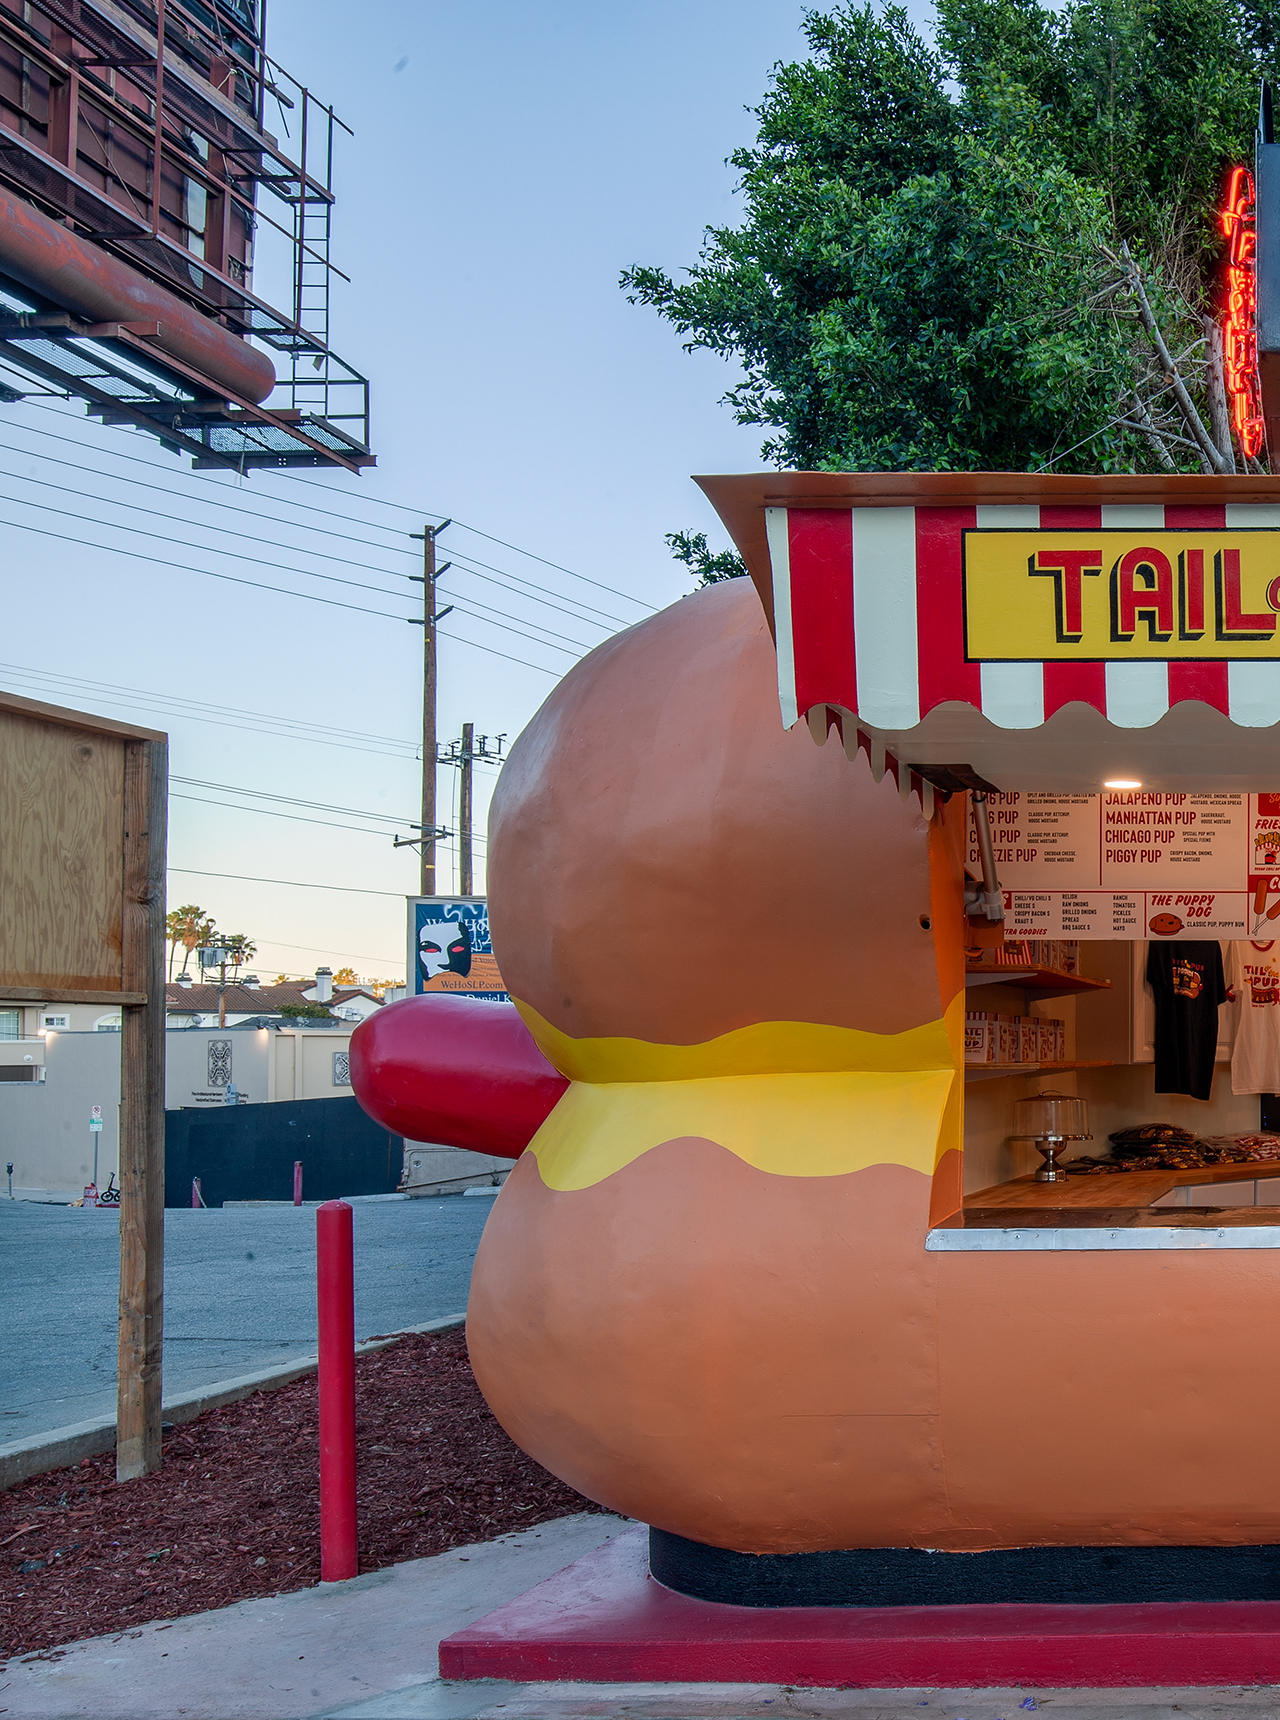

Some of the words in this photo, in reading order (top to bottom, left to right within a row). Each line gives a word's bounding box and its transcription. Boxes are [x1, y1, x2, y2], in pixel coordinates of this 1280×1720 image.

[1028, 546, 1278, 643] TAIL
[999, 792, 1020, 805] PUP
[1165, 792, 1187, 805] PUP
[969, 811, 995, 824] 16
[998, 811, 1019, 824] PUP
[1106, 811, 1172, 825] MANHATTAN
[1175, 811, 1197, 825] PUP
[1000, 830, 1021, 843] PUP
[1105, 830, 1151, 843] CHICAGO
[1154, 830, 1175, 843] PUP
[1016, 849, 1037, 862] PUP
[1106, 849, 1138, 863] PIGGY
[1140, 849, 1162, 863] PUP
[1151, 894, 1173, 906] THE
[1175, 894, 1215, 906] PUPPY
[1186, 906, 1212, 918] DOG
[440, 980, 503, 989] WeHoSLP.com
[1253, 976, 1280, 987] PUP
